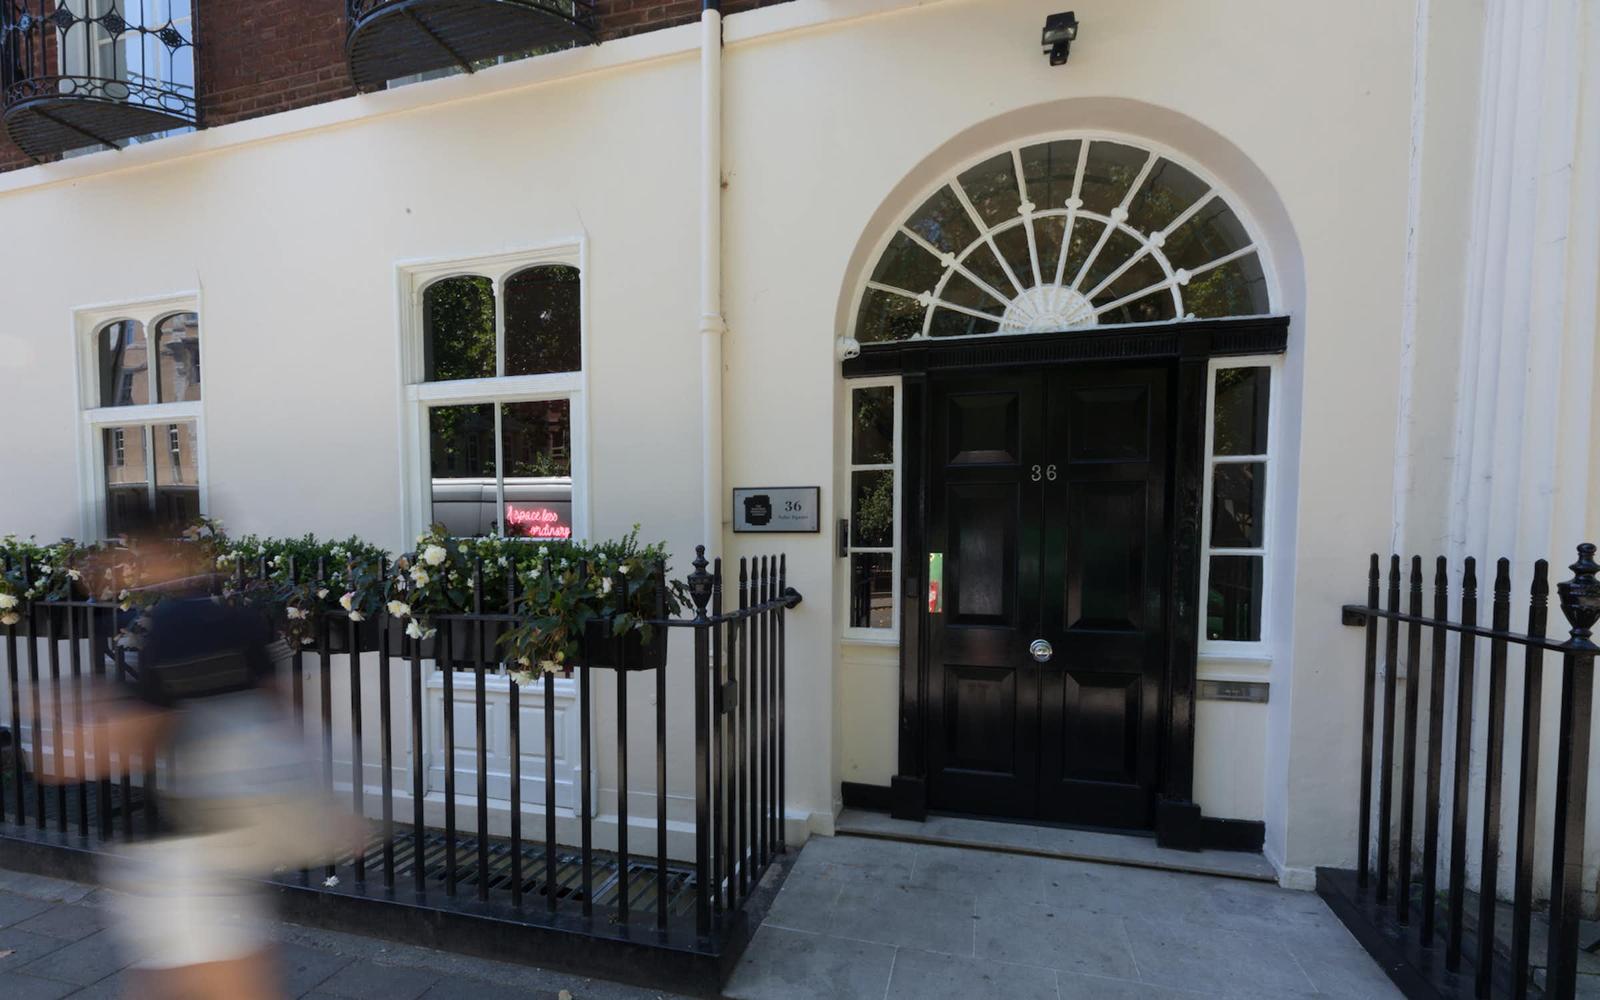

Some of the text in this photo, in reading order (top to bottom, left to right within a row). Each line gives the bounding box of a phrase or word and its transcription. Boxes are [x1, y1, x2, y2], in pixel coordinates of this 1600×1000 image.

[1031, 464, 1057, 482] 36
[784, 500, 802, 512] 36
[513, 510, 541, 524] space
[541, 508, 558, 522] less
[530, 524, 571, 538] ordinary
